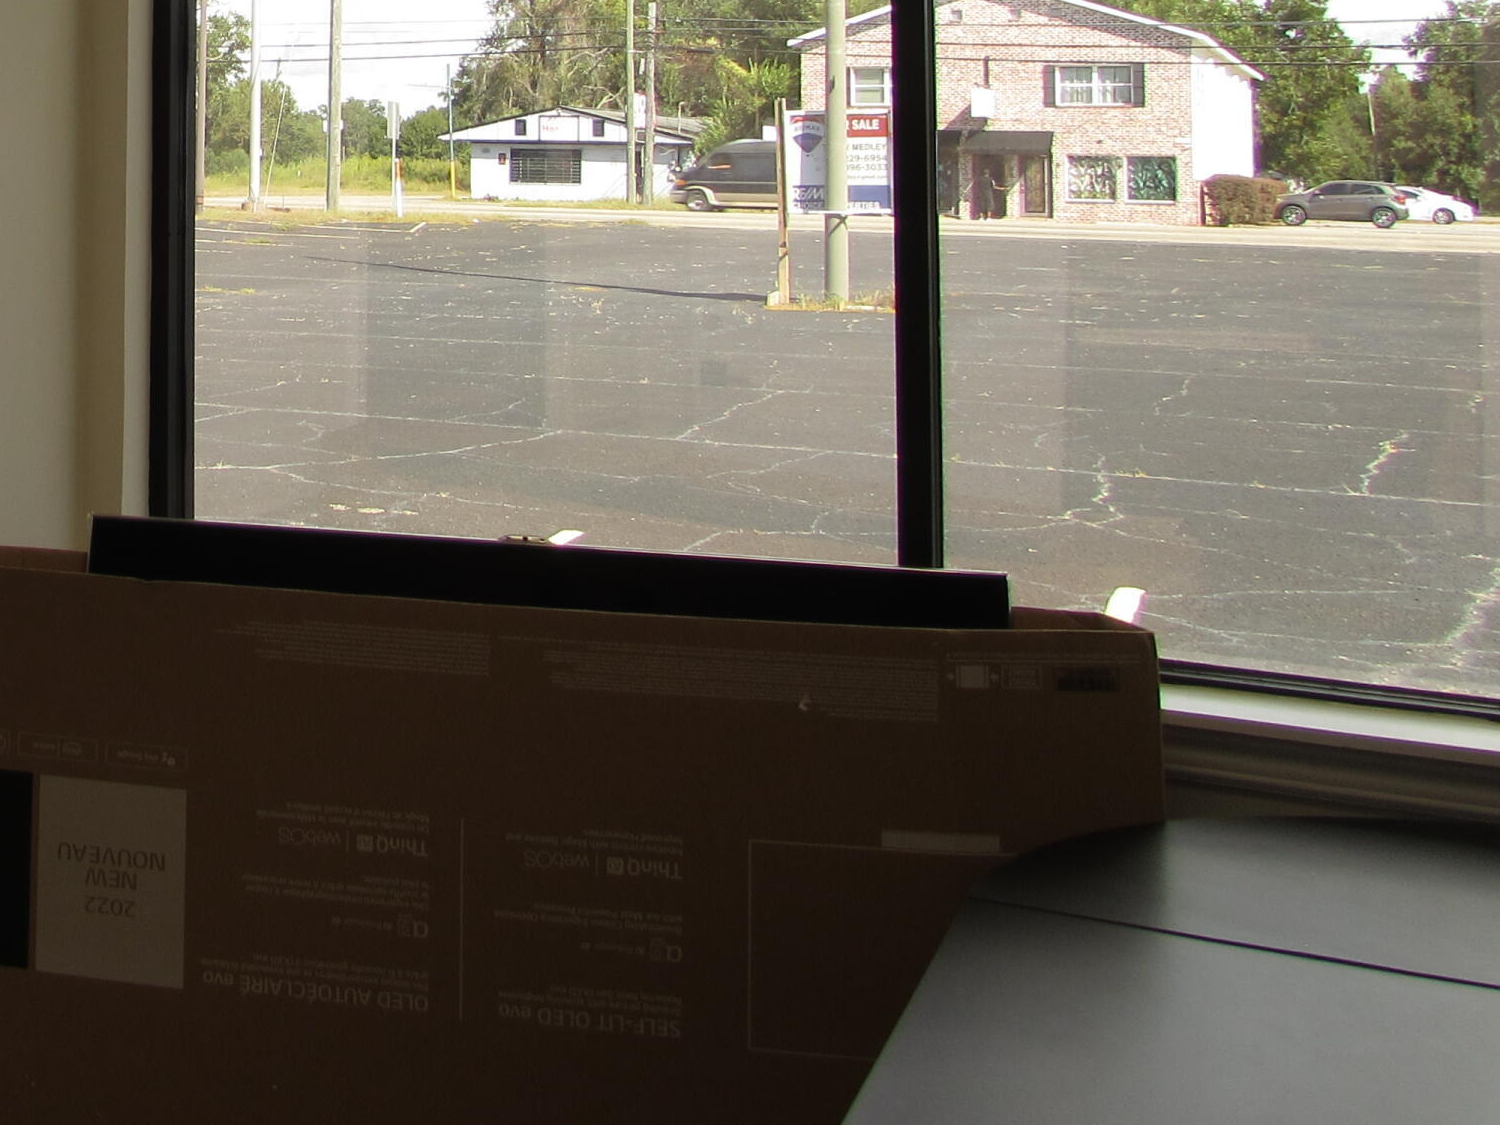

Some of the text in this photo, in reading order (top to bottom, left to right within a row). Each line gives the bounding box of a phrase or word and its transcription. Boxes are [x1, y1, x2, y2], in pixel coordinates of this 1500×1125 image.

[852, 118, 880, 130] SALE
[851, 143, 887, 151] MEDLEY
[278, 826, 341, 846] webOS
[376, 834, 429, 857] ThinQ
[57, 842, 166, 872] NOUVEAU
[523, 849, 590, 870] webOS
[627, 857, 683, 880] ThinQ
[84, 868, 138, 891] NEW
[83, 895, 137, 918] 2022
[202, 970, 234, 987] evo
[239, 974, 372, 1007] AUTOÉCLAIRÉ
[377, 990, 429, 1012] OLED
[498, 1003, 531, 1019] evo
[537, 1007, 591, 1030] OLED
[596, 1013, 682, 1039] SELF-LIT
